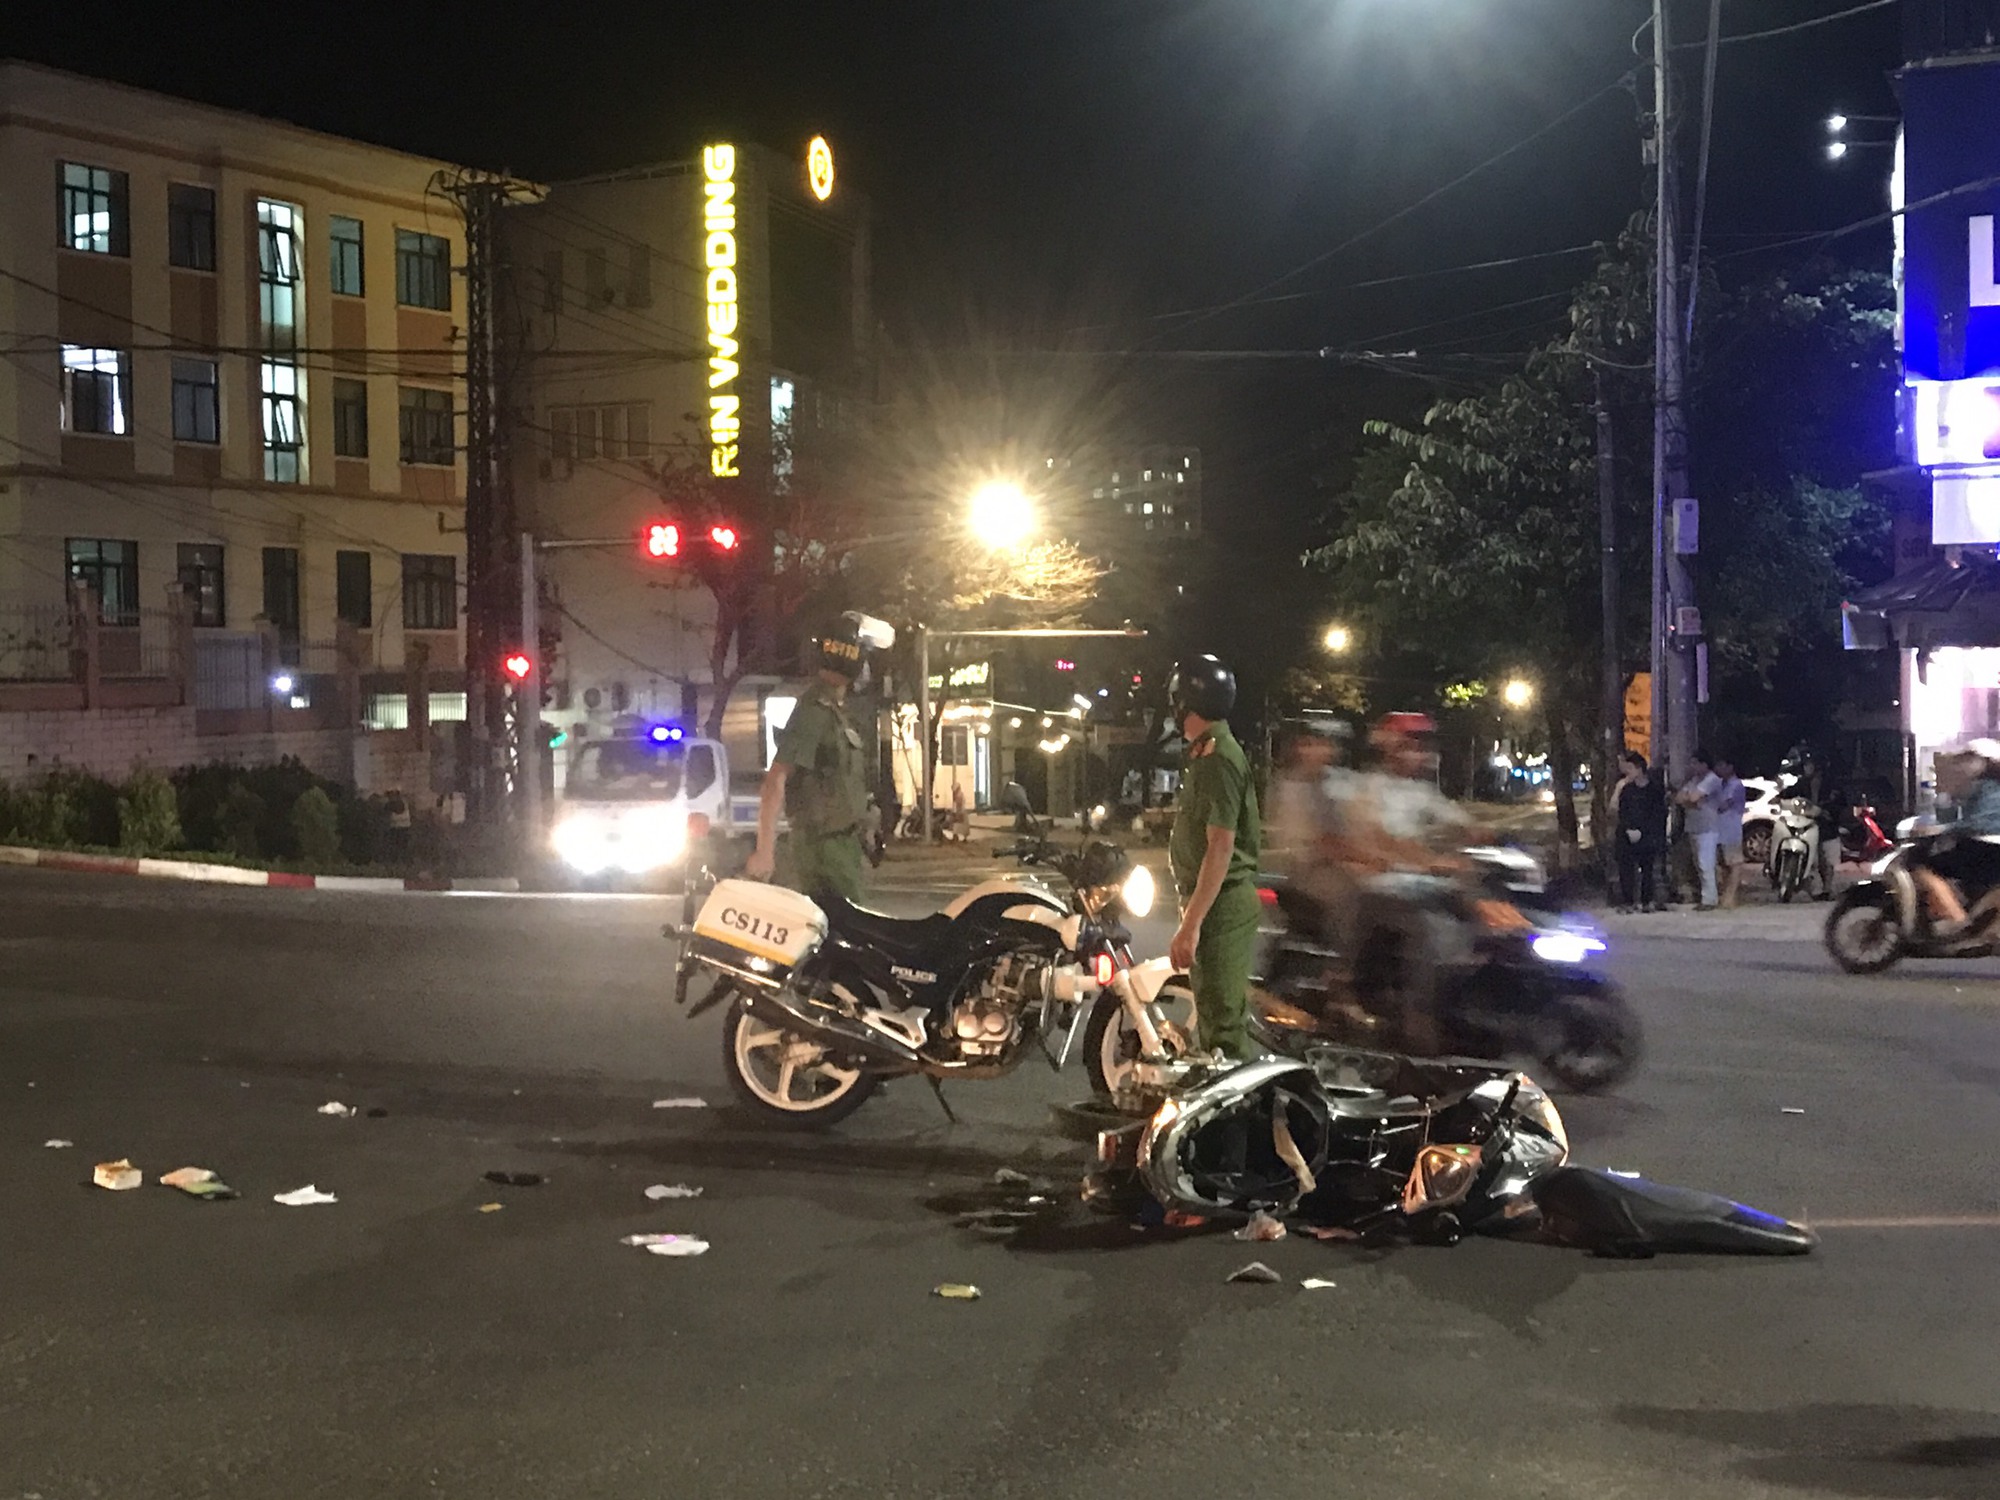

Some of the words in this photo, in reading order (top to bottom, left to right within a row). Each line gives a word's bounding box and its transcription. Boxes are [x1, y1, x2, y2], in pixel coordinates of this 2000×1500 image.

[703, 143, 740, 390] WEDDING
[711, 394, 740, 478] RIN
[720, 907, 789, 946] CS113
[890, 965, 938, 984] POLICE
